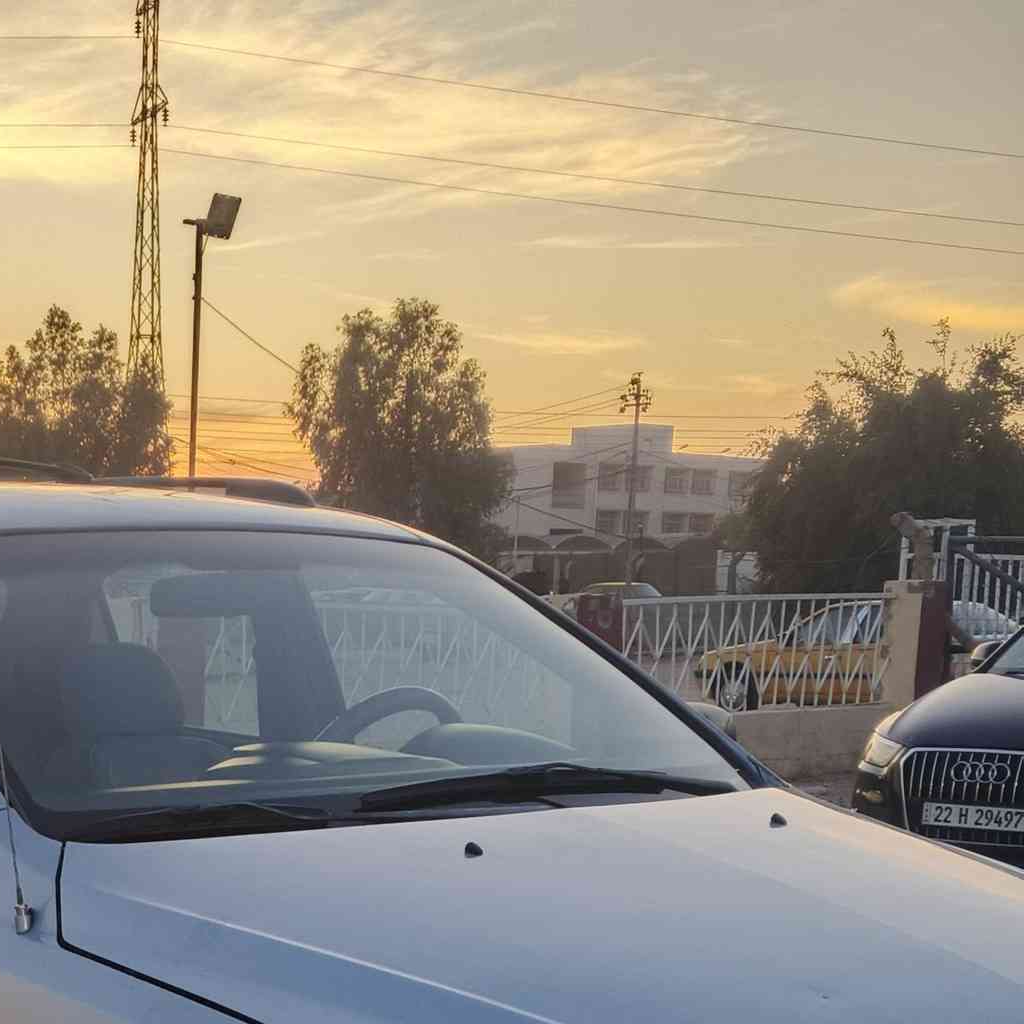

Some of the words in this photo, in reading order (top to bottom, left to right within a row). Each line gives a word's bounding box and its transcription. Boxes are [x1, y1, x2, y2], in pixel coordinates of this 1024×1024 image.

[934, 806, 952, 823] 22
[959, 808, 968, 824] H
[974, 809, 1024, 828] 29497
